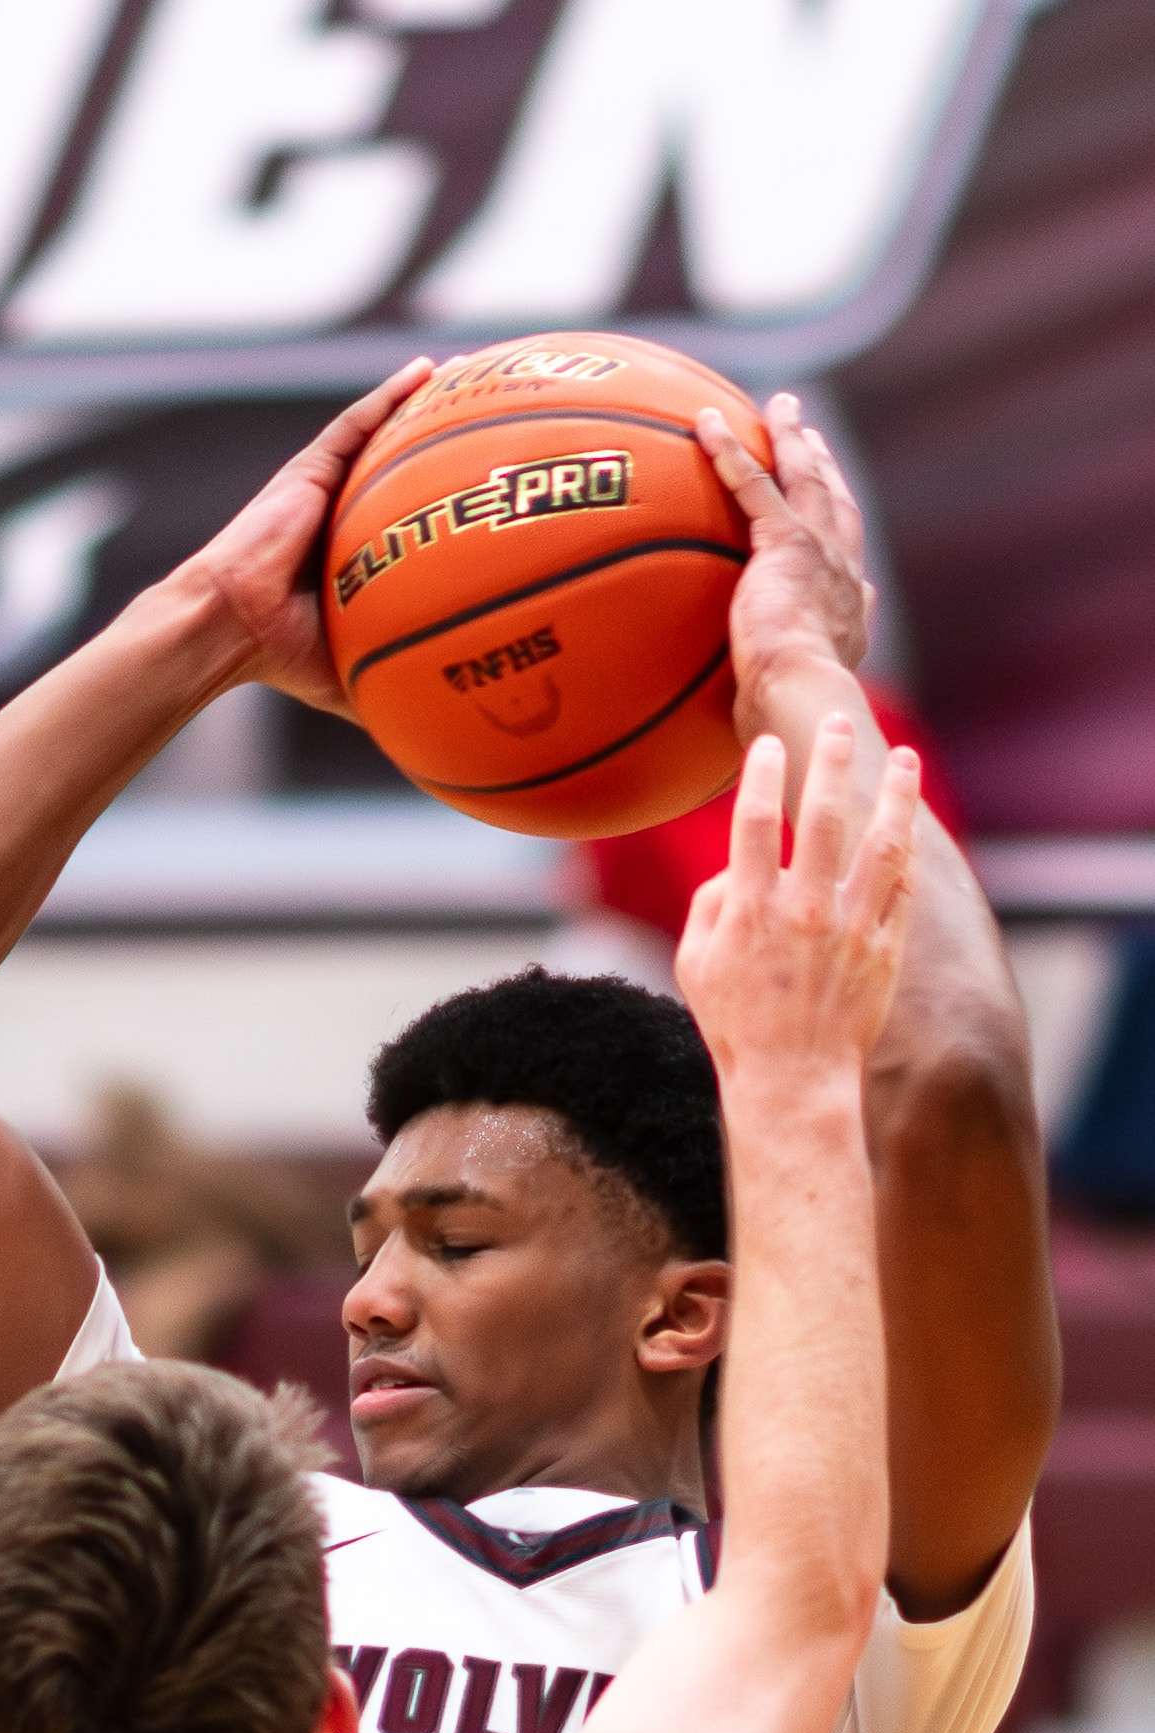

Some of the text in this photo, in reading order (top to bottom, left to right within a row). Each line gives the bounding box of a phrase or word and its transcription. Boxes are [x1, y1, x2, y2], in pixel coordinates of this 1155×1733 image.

[334, 454, 628, 612] ELITE PRO
[464, 627, 561, 688] NFHS
